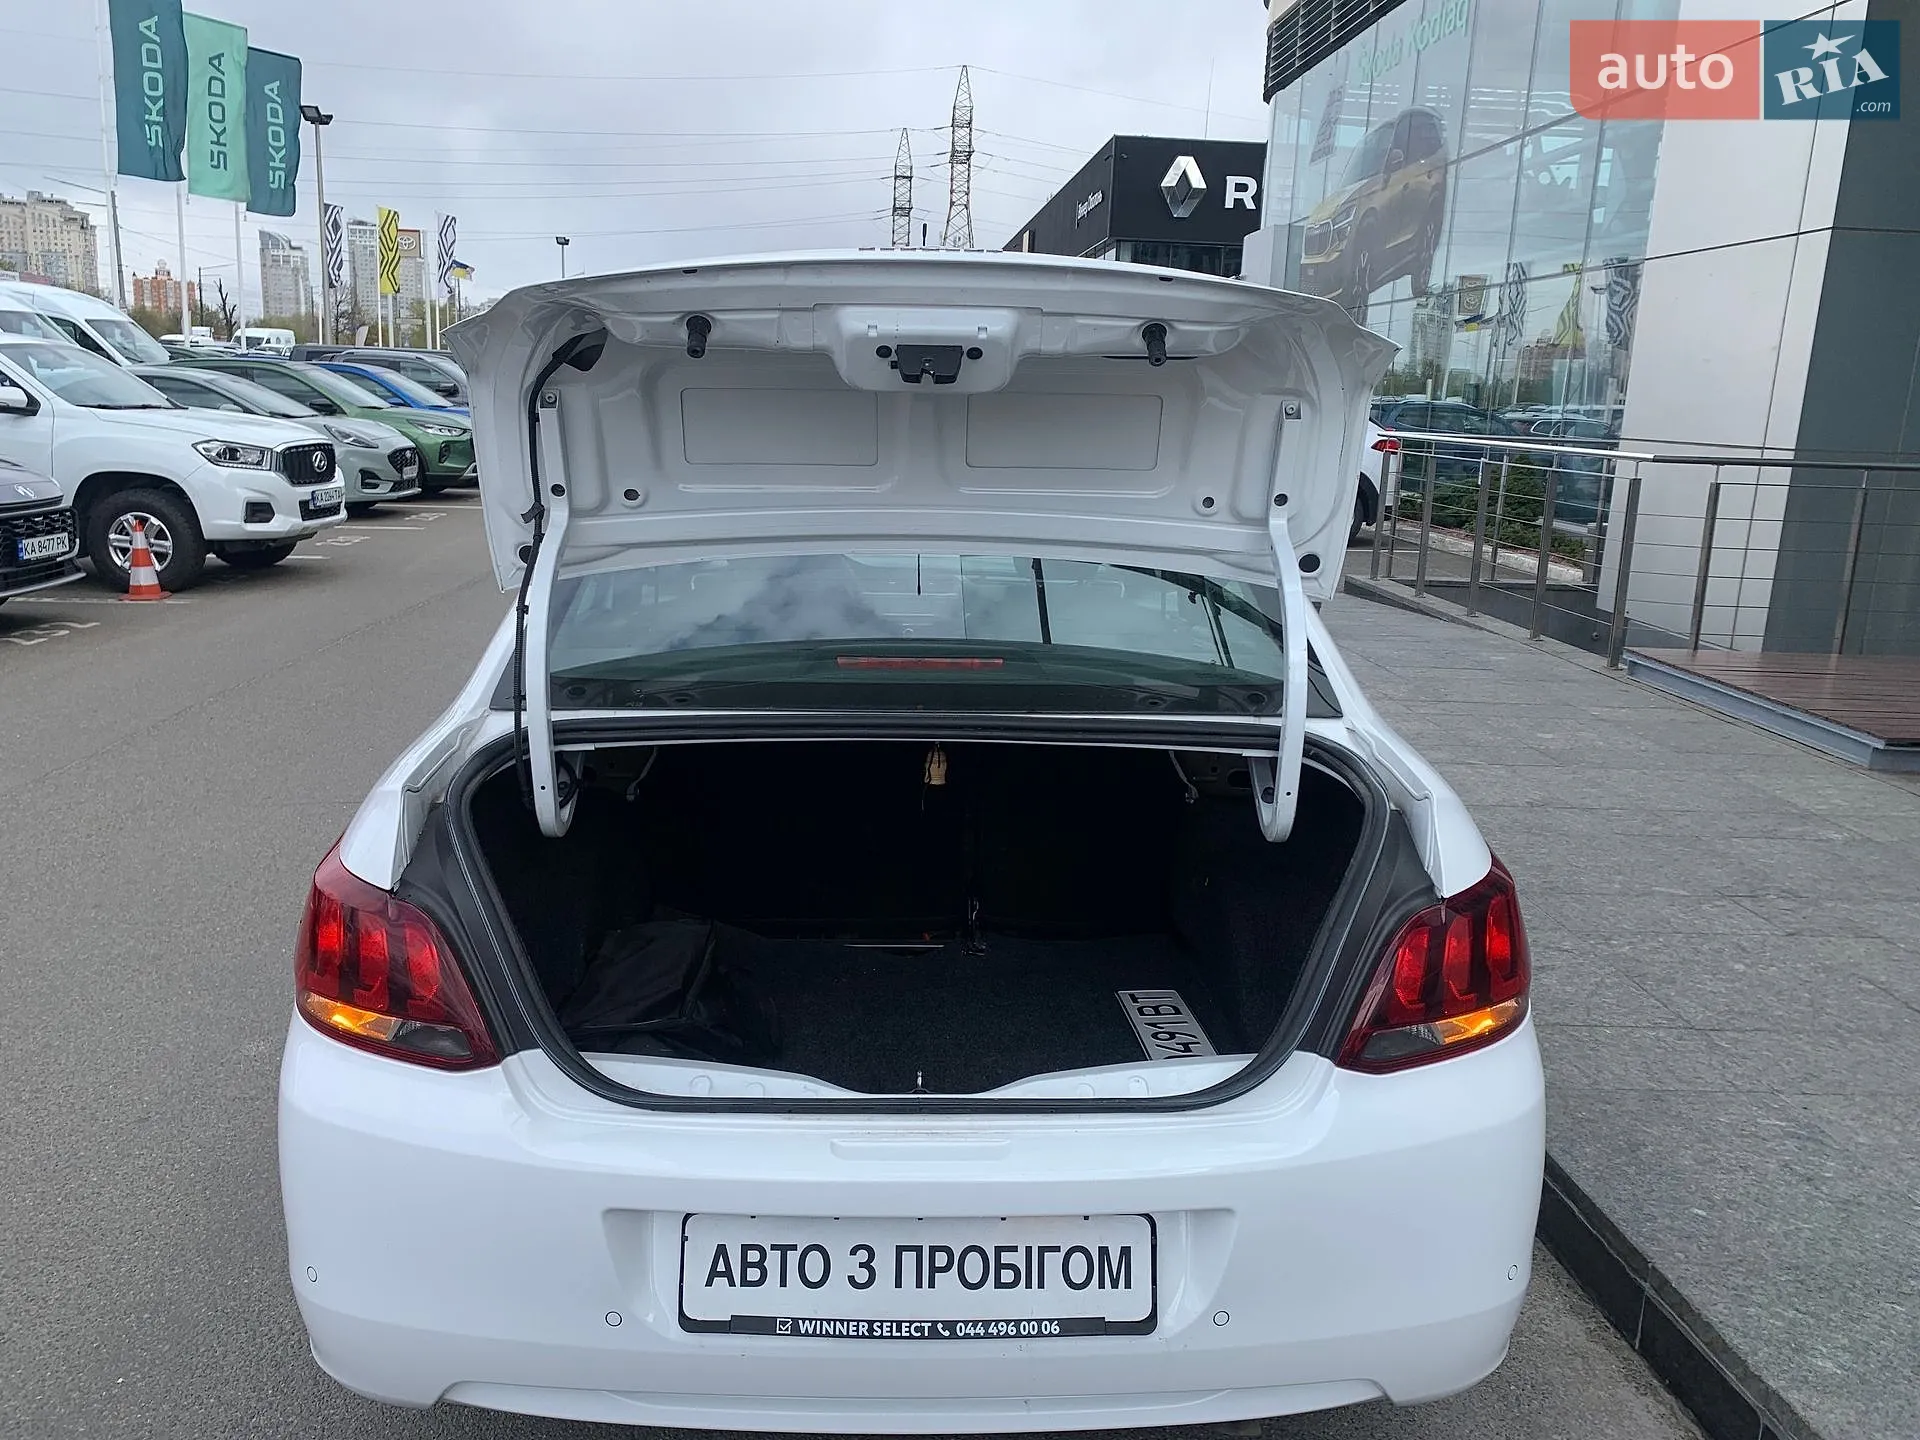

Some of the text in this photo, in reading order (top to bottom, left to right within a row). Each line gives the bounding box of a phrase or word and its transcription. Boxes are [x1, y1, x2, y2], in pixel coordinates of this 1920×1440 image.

[24, 536, 67, 556] KA 8477 PK
[704, 1243, 831, 1289] АВТО
[894, 1244, 1132, 1290] ПРОБІГОМ
[798, 1319, 1060, 1337] WINNER SELECT 044 496 00 06
